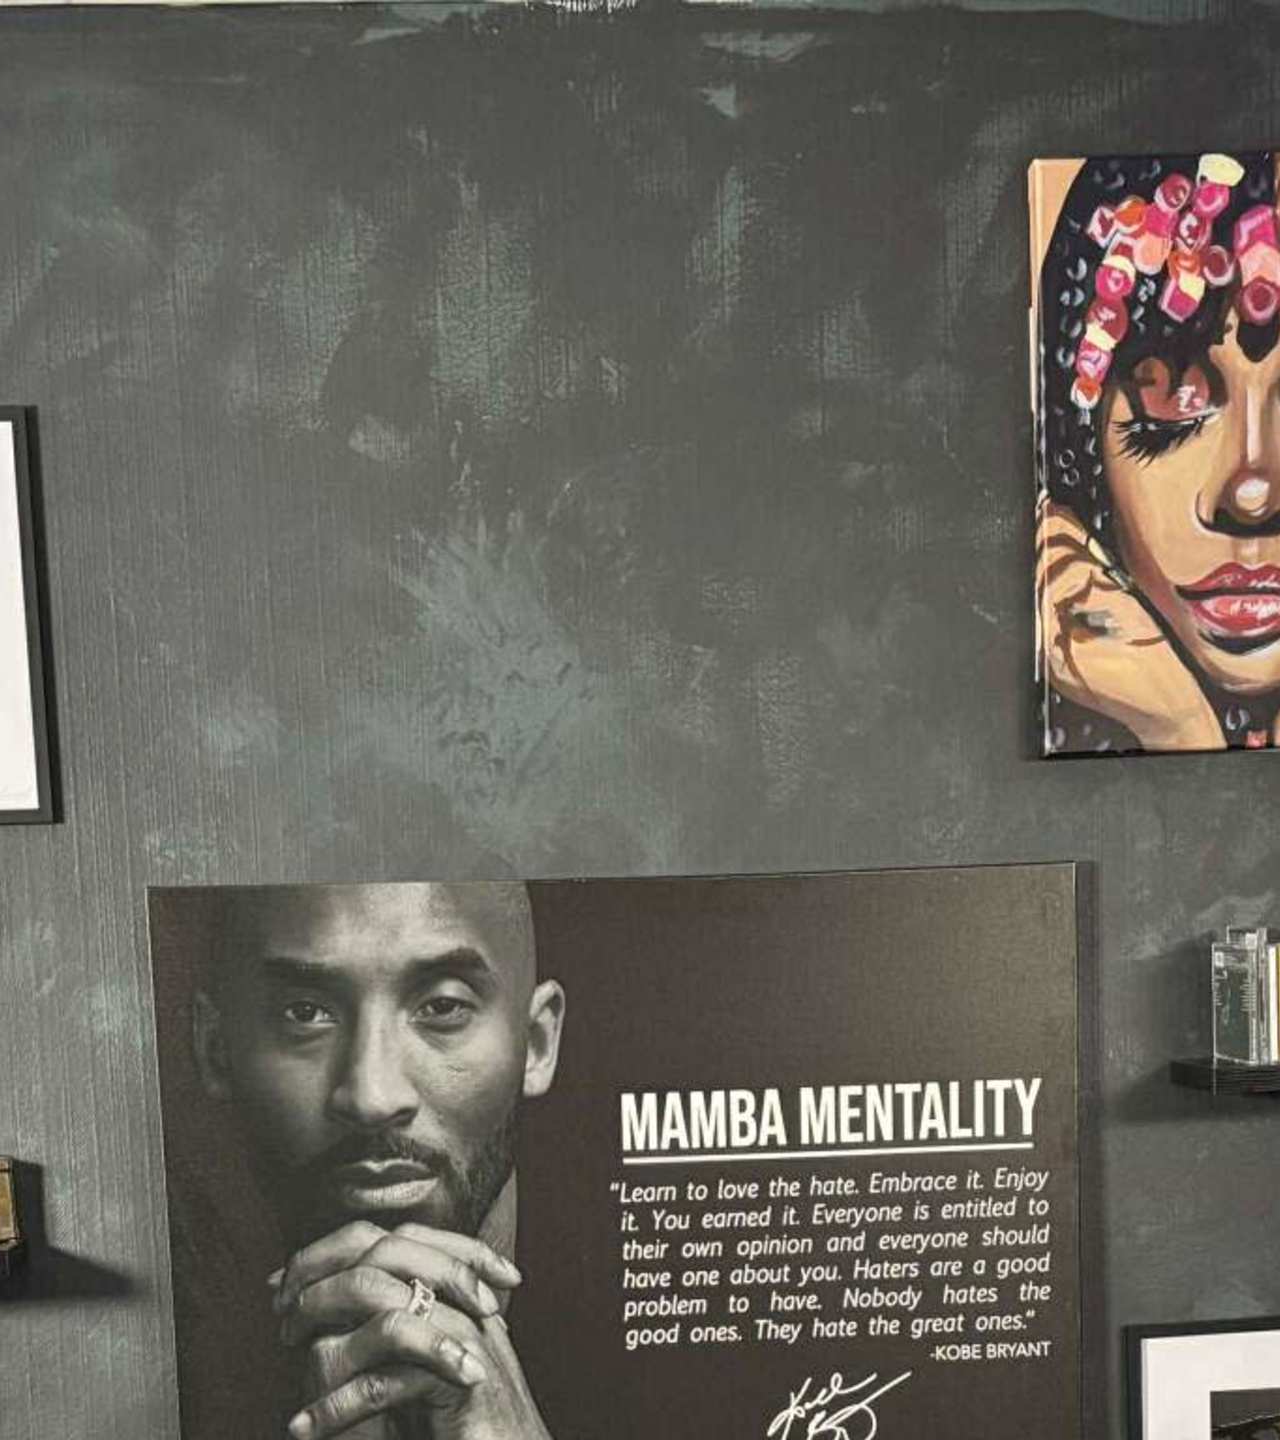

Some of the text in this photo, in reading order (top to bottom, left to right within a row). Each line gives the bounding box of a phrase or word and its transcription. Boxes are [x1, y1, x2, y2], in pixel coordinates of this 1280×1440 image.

[620, 1077, 1042, 1151] MAMBA MENTALITY
[686, 1181, 709, 1201] to
[717, 1178, 760, 1200] love
[768, 1176, 801, 1198] the
[809, 1174, 860, 1197] hate.
[868, 1170, 958, 1195] Embrace
[965, 1169, 985, 1191] it.
[993, 1165, 1050, 1193] Enjoy
[620, 1195, 1050, 1232] it. You earned it. Everyone is entitled to
[622, 1221, 1051, 1261] their own opinion and everyone should
[622, 1251, 1052, 1289] have one about you. Haters are a good
[623, 1279, 1052, 1323] problem to have. Nobody hates the
[625, 1322, 681, 1351] good
[689, 1325, 743, 1344] ones.
[754, 1318, 803, 1345] They
[811, 1317, 858, 1338] hate
[868, 1314, 901, 1337] the
[910, 1313, 965, 1340] great
[985, 1340, 1052, 1360] BRYANT
